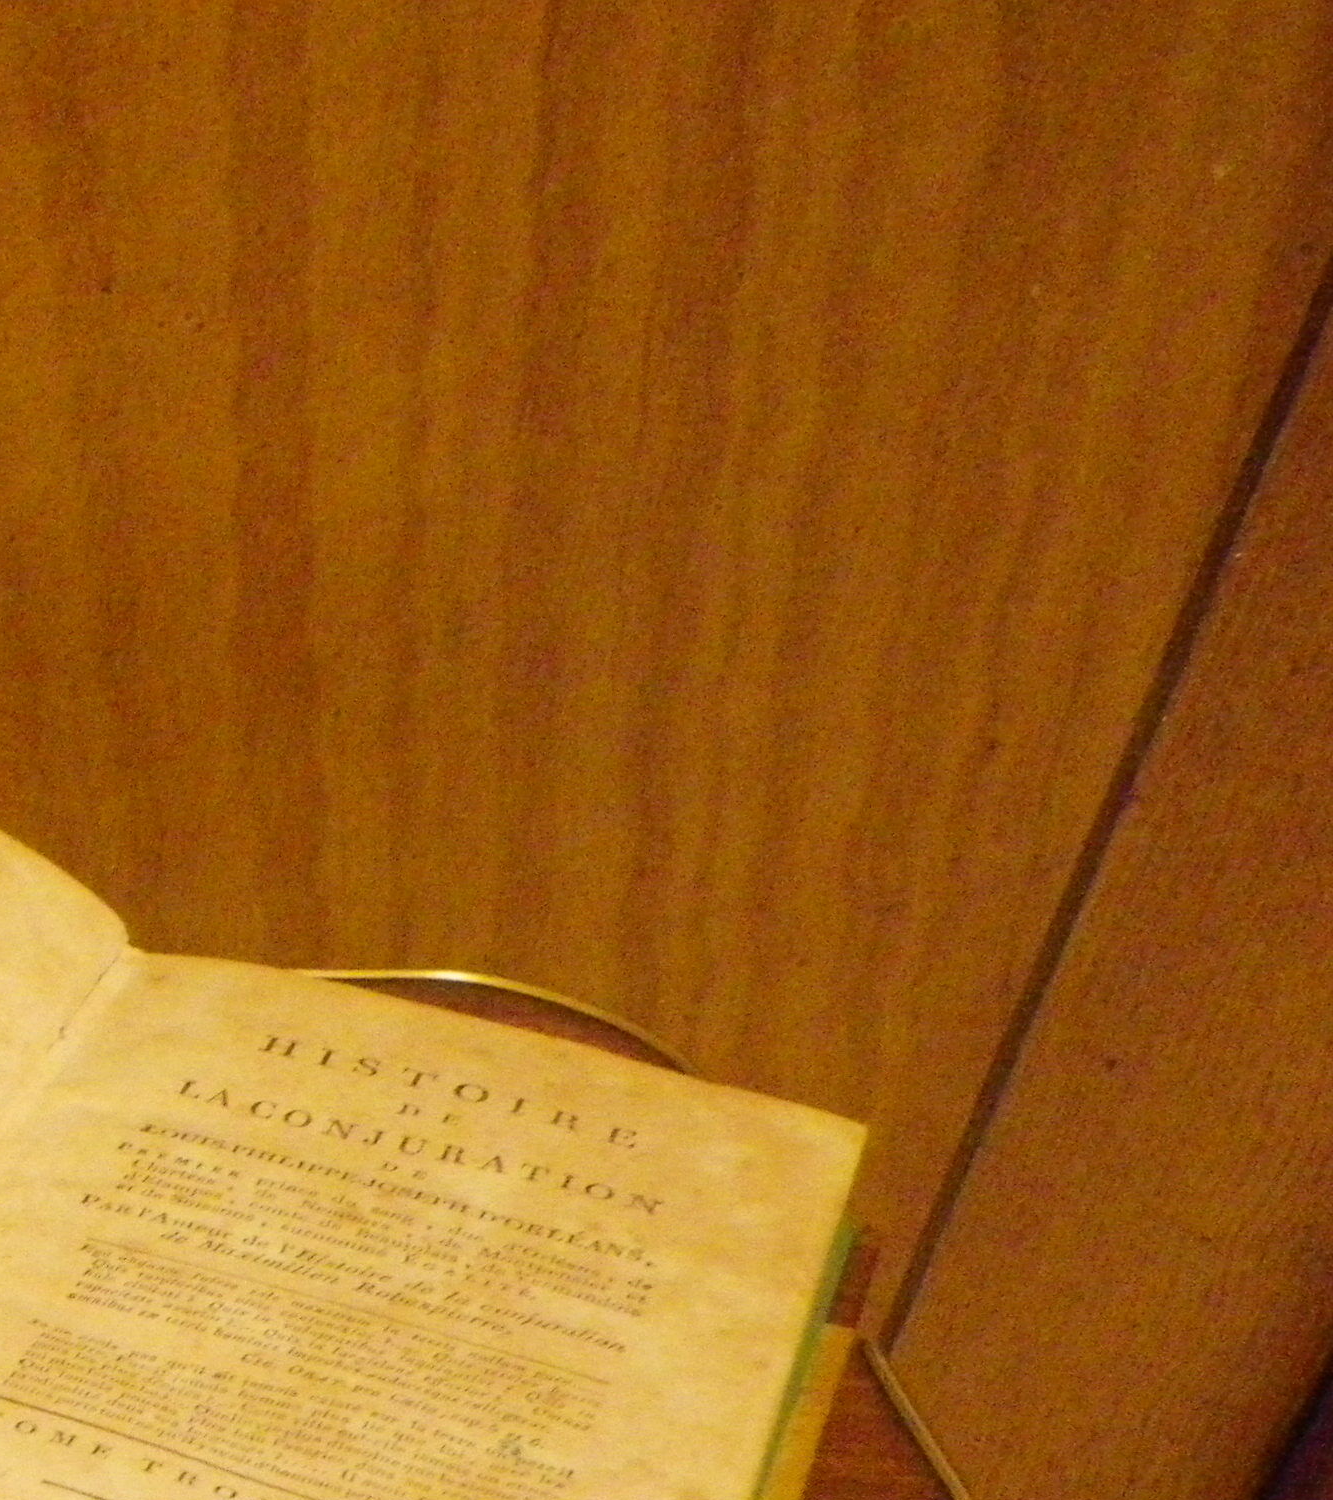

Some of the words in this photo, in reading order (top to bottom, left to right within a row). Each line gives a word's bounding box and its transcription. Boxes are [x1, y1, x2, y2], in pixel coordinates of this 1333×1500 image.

[178, 1080, 231, 1107] LA
[250, 1099, 664, 1216] CONJURATION
[259, 1034, 638, 1149] HISTOIRE
[398, 1103, 459, 1126] DE
